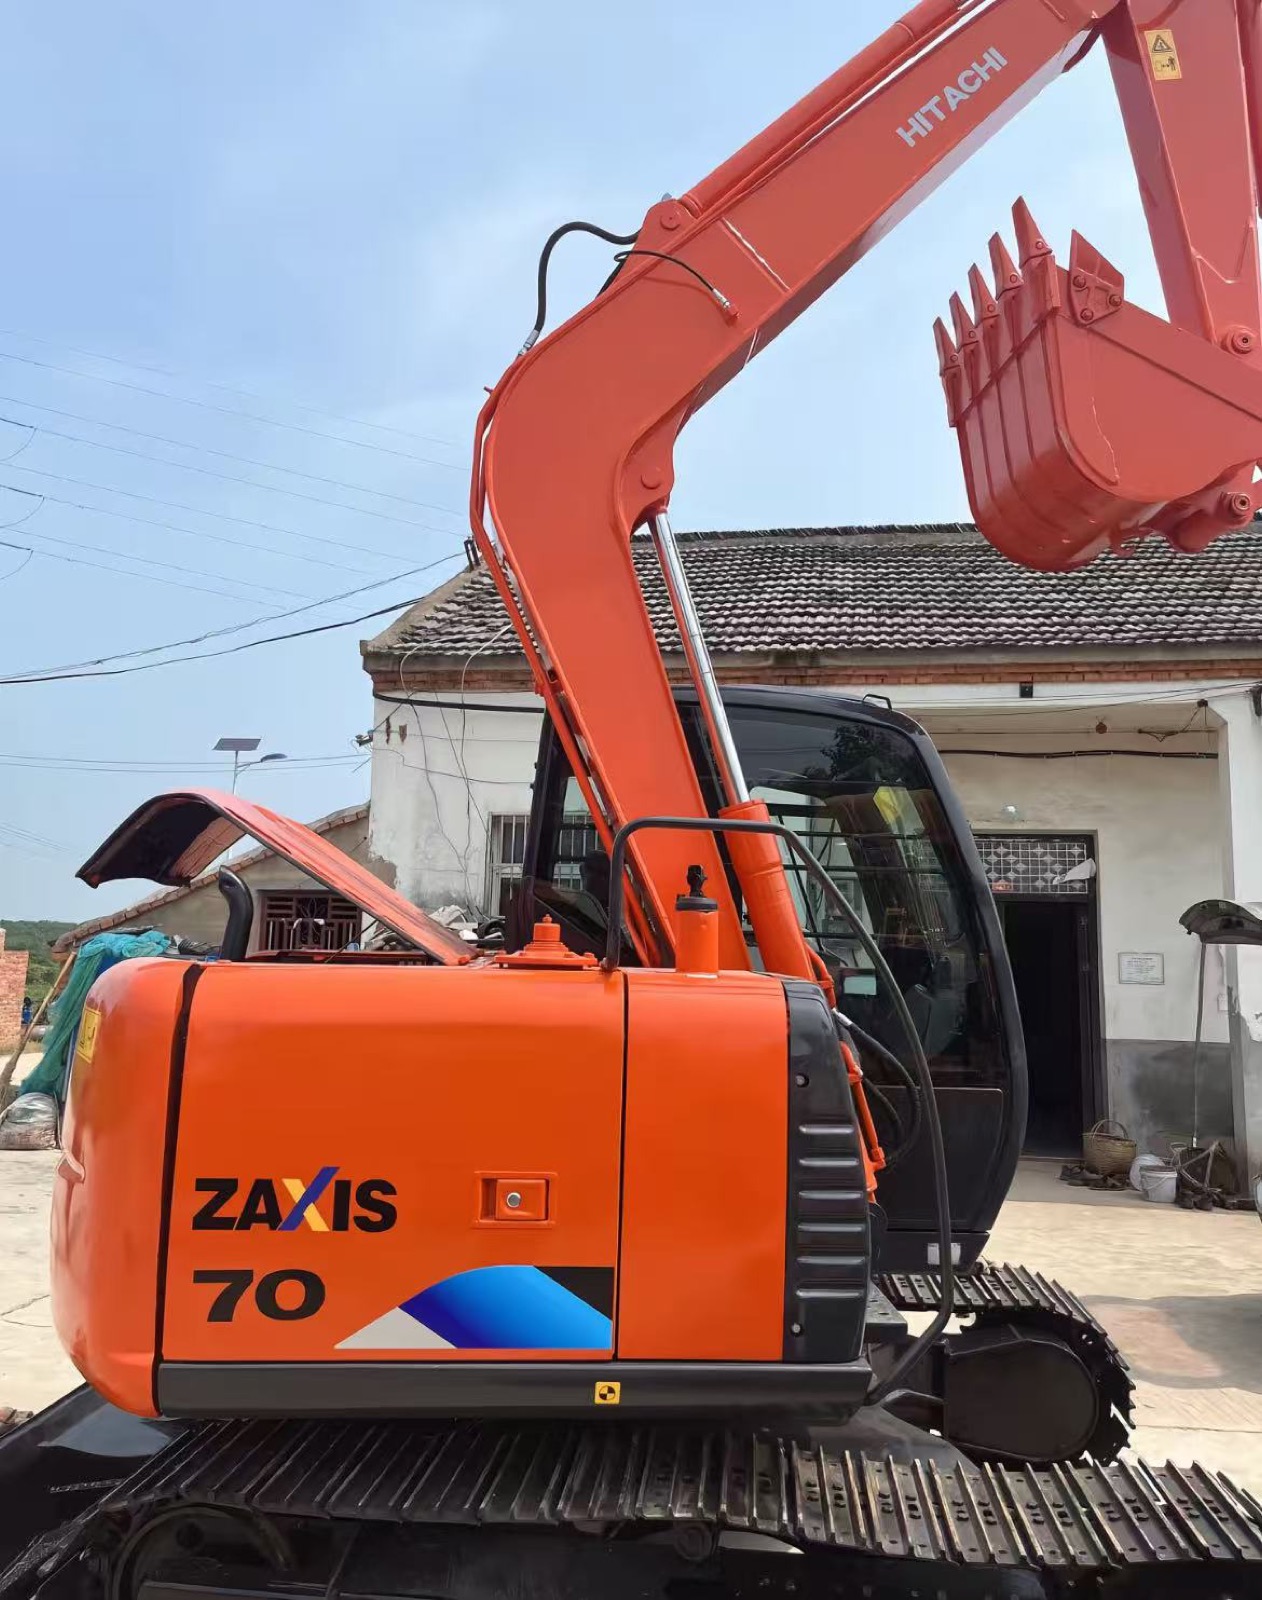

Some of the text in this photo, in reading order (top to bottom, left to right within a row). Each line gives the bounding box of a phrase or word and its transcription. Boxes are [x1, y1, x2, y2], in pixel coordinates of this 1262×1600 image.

[896, 46, 1008, 148] HITACHI
[192, 1166, 398, 1233] ZAXIS
[193, 1269, 326, 1322] 70
